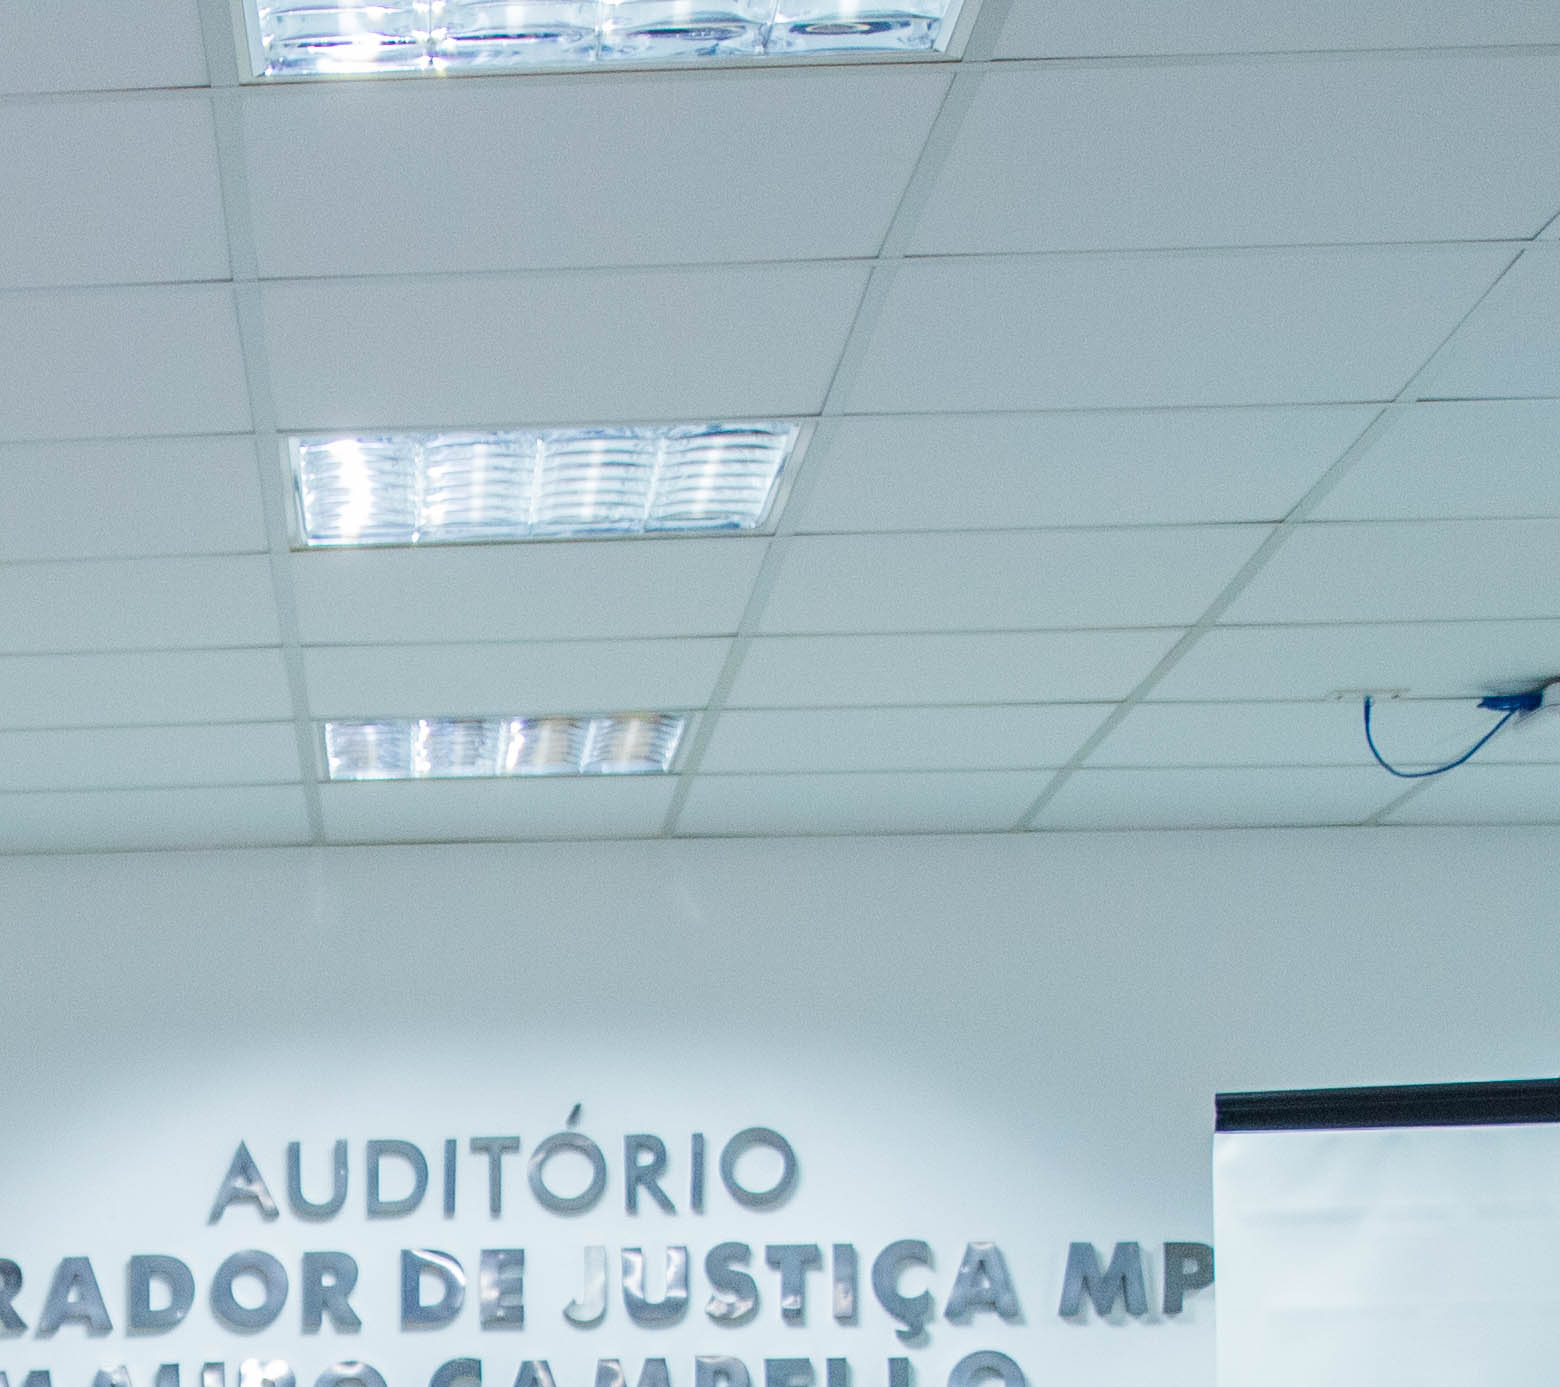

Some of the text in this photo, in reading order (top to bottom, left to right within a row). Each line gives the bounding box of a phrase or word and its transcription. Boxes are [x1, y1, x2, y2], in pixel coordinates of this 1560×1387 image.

[207, 1103, 797, 1225] AUDITÓRIO
[400, 1248, 525, 1332] DE
[563, 1240, 1018, 1343] JUSTIÇA
